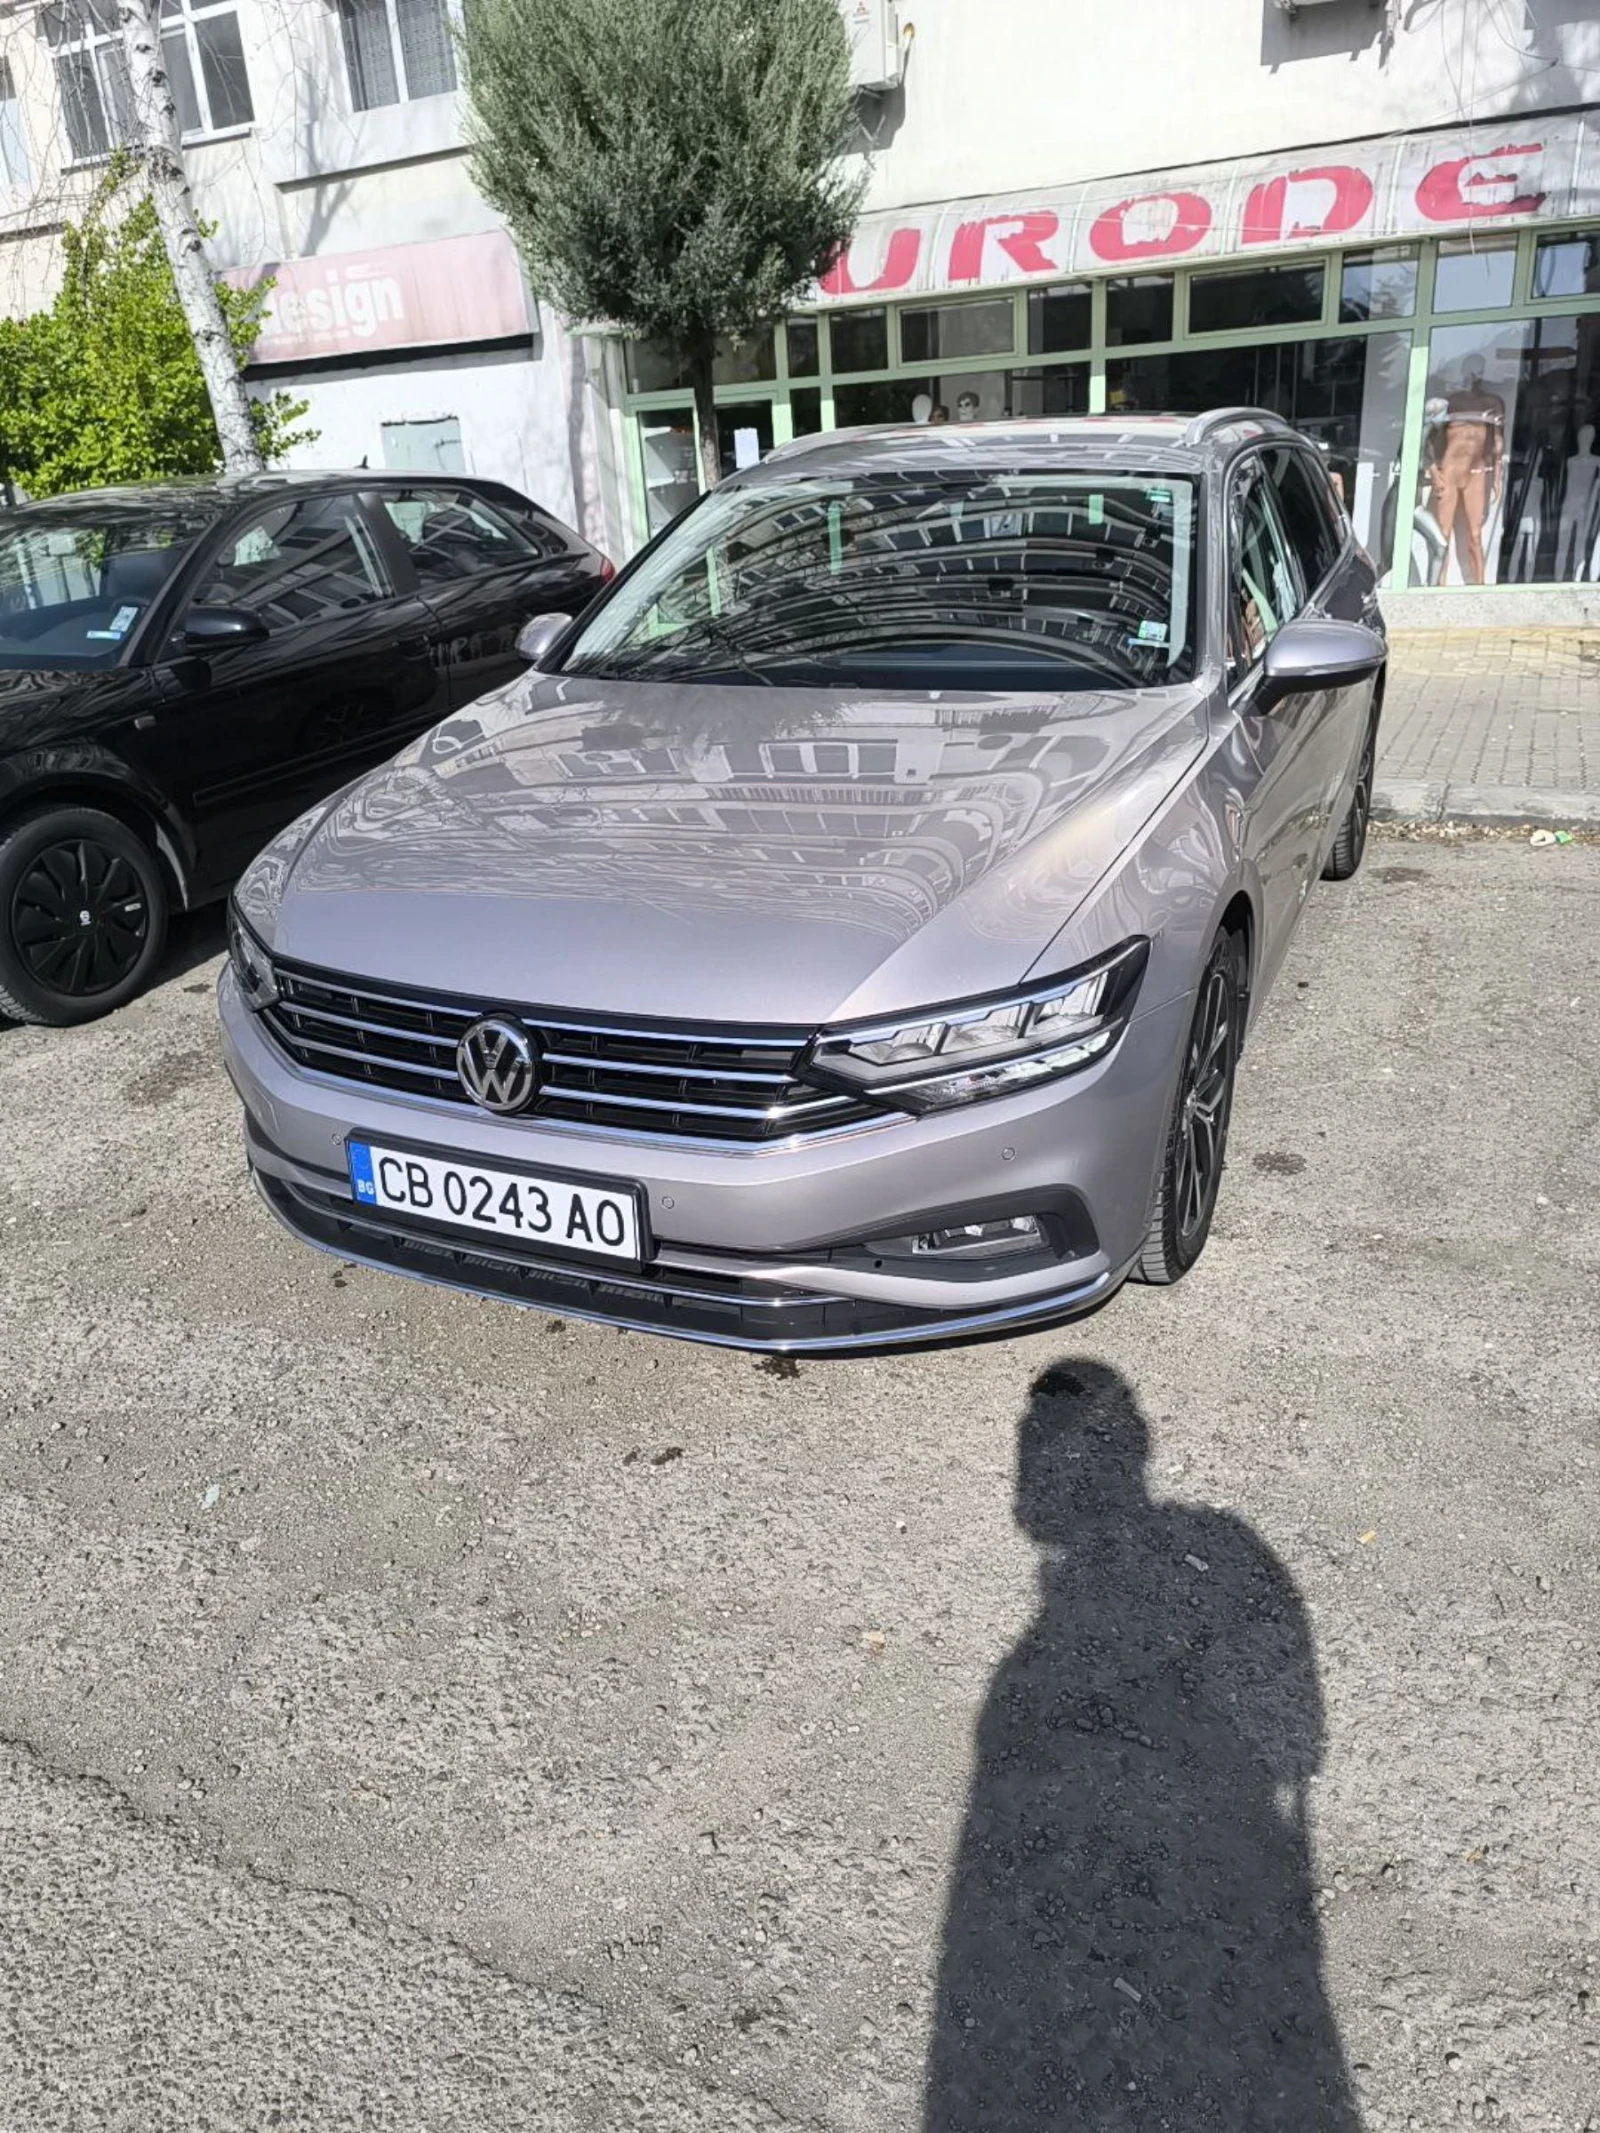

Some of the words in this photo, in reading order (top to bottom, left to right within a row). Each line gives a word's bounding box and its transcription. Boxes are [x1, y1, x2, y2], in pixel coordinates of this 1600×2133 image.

[460, 1024, 527, 1107] VW
[357, 1179, 374, 1195] BG
[379, 1157, 433, 1208] CB
[444, 1171, 551, 1233] 0243
[566, 1193, 624, 1246] AO
